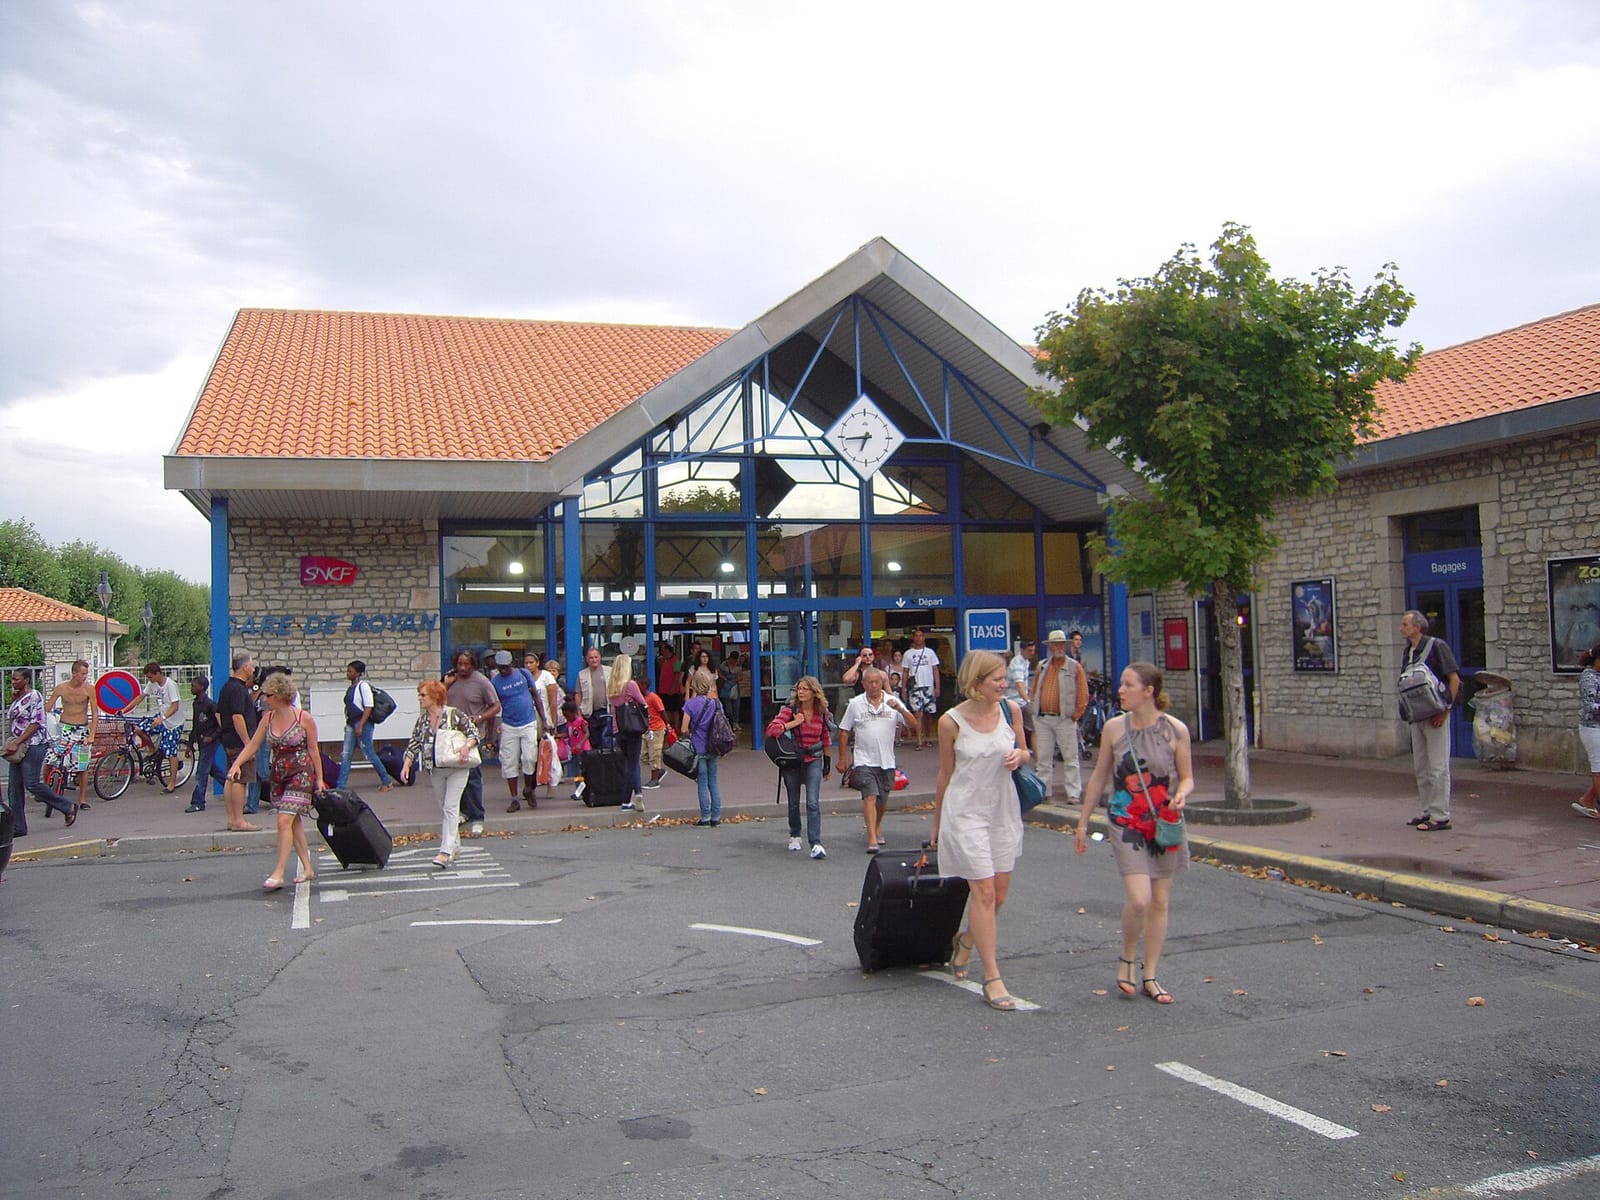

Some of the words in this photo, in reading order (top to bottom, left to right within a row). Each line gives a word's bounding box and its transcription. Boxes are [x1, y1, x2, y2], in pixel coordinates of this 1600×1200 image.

[303, 566, 353, 581] SNCF
[1431, 562, 1467, 575] Bagages
[1578, 565, 1600, 578] ZO
[918, 597, 943, 607] Départ
[304, 613, 340, 635] DE
[349, 612, 439, 633] ROYAN
[970, 624, 1006, 639] TAXIS
